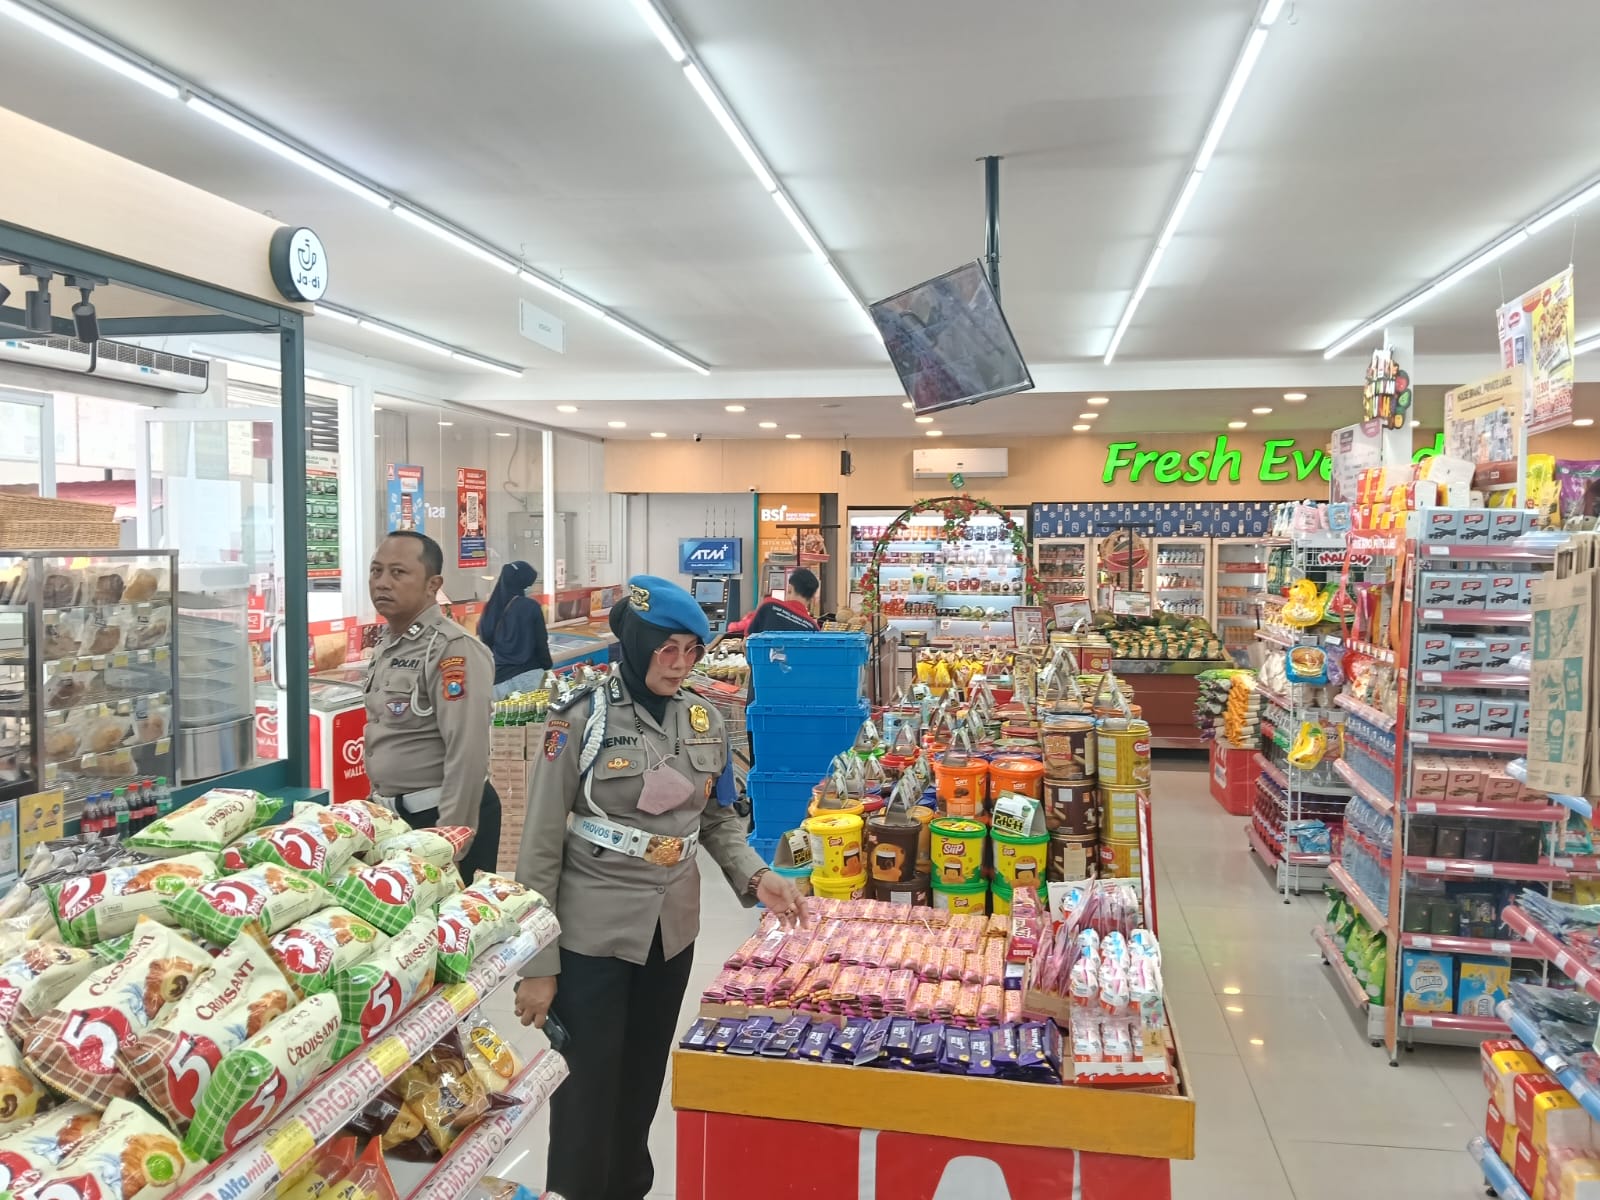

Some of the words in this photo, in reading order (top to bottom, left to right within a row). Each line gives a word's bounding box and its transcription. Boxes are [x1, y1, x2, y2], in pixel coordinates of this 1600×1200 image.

[1101, 434, 1241, 484] Fresh
[390, 658, 420, 669] POLRI
[582, 820, 611, 839] PROVOS
[269, 830, 313, 870] 5
[312, 844, 327, 874] DAYS
[358, 867, 403, 904] 5
[271, 933, 318, 970] 5
[455, 927, 471, 954] DAYS
[366, 977, 395, 1039] 5
[61, 1013, 120, 1069] 5
[231, 1073, 281, 1147] 5
